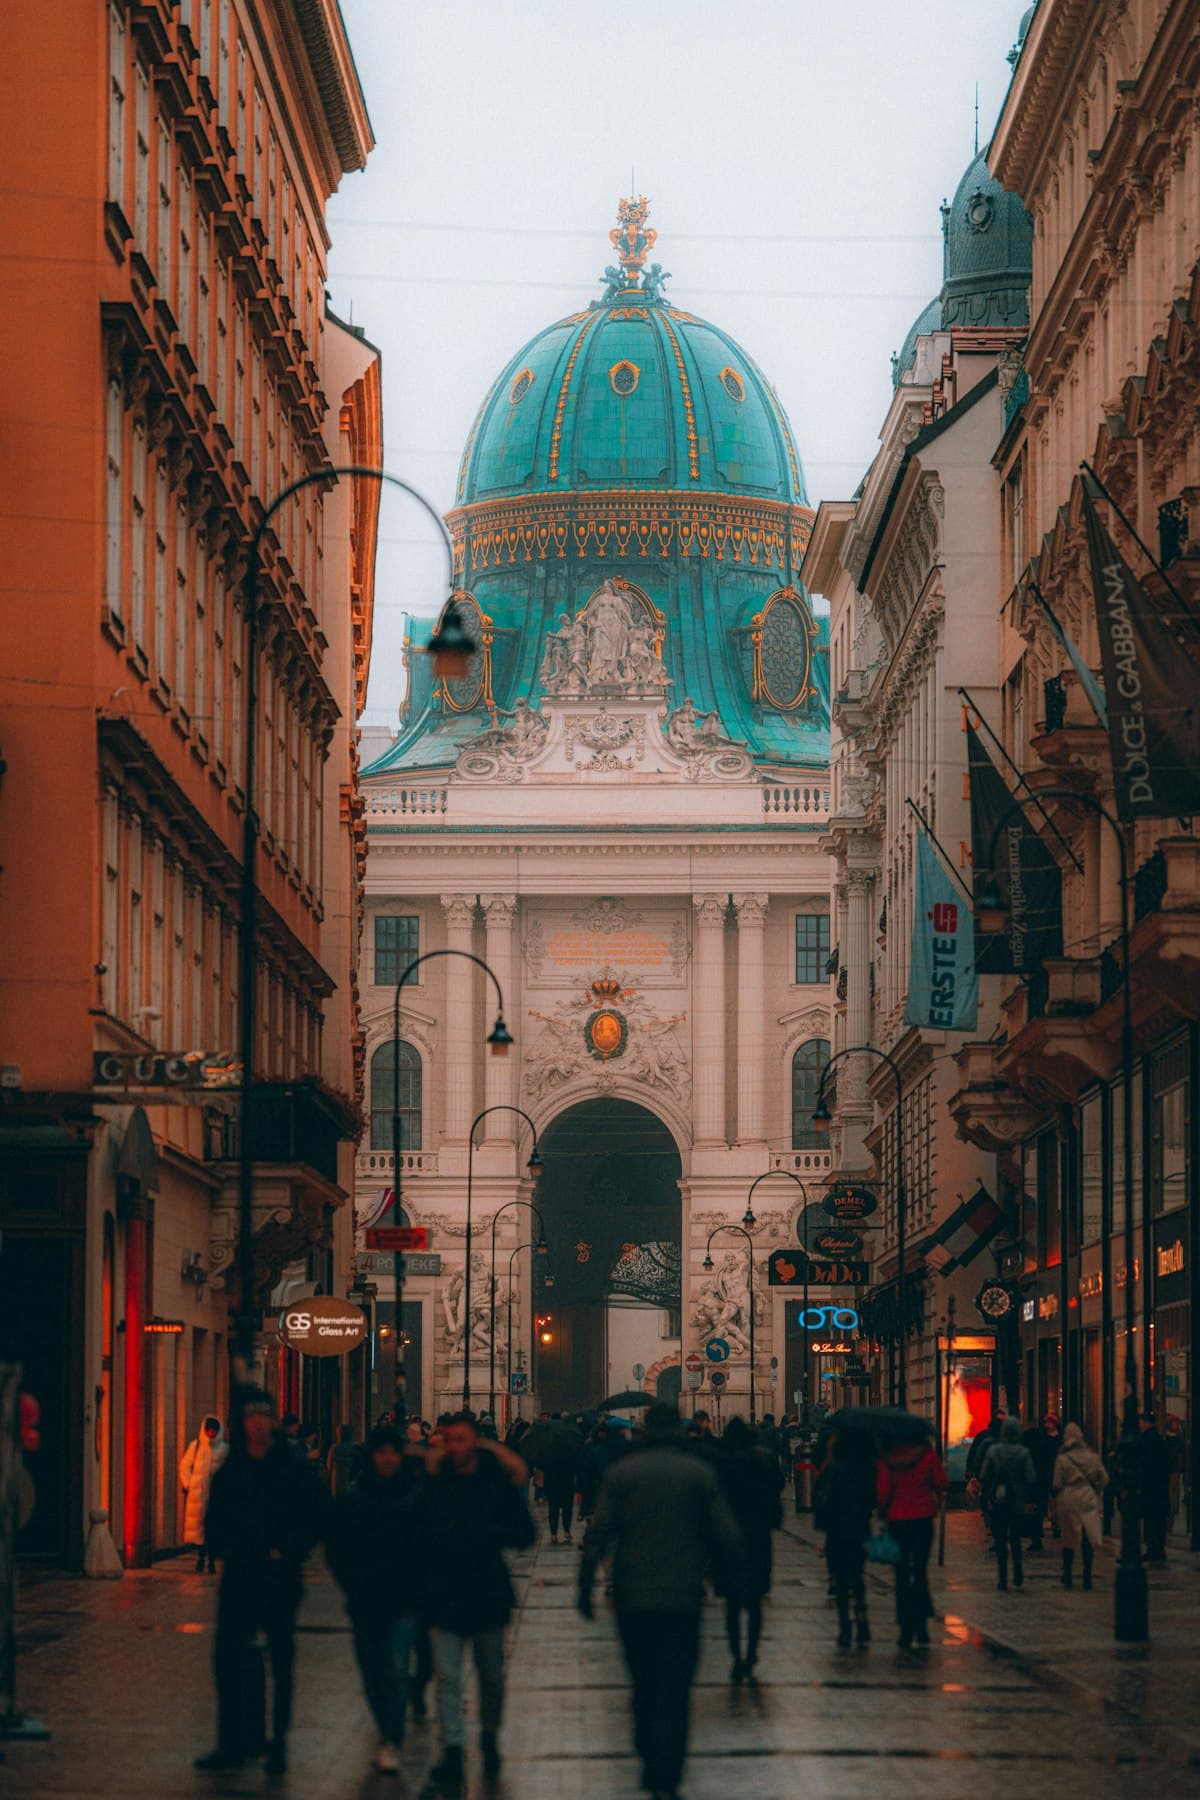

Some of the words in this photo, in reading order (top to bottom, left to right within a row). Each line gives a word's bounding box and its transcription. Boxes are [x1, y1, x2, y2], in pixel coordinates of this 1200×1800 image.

[1102, 562, 1142, 698] GABBANA
[1130, 700, 1143, 713] &
[1121, 715, 1154, 803] DOLCE
[929, 937, 957, 1027] ERSTE
[834, 1197, 865, 1206] DEMEL
[360, 1255, 437, 1271] APOEKE
[807, 1262, 862, 1284] DoDo
[286, 1312, 311, 1330] GS
[313, 1314, 364, 1325] International
[318, 1326, 343, 1336] Glass
[344, 1327, 360, 1336] Art
